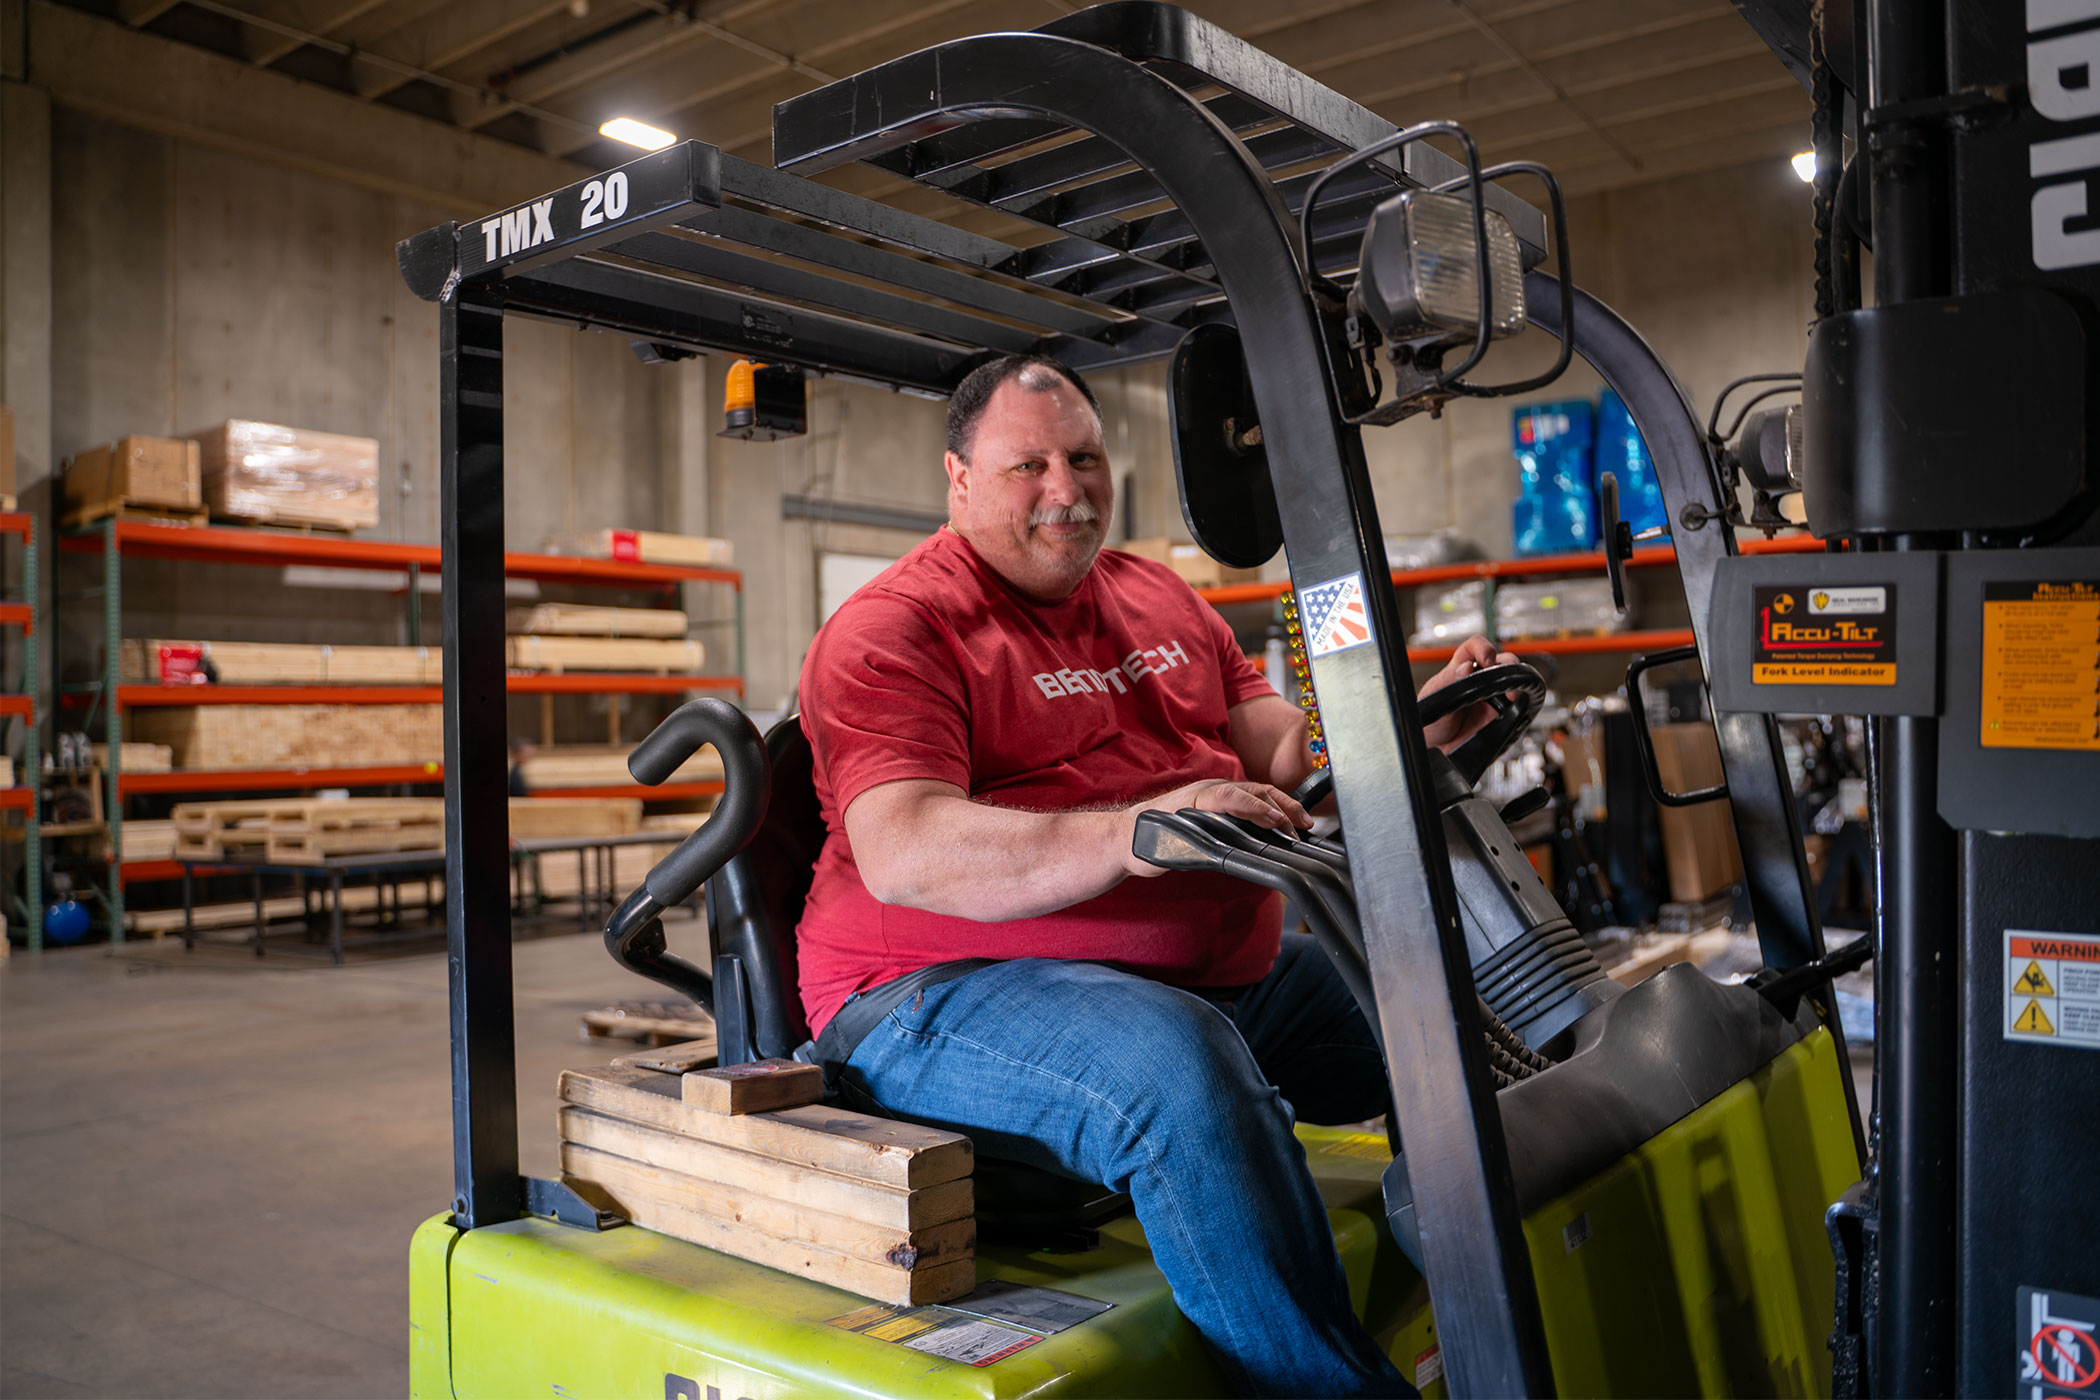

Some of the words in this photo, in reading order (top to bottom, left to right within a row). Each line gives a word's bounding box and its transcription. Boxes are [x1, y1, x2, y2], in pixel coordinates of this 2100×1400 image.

[481, 198, 555, 263] TMX
[580, 171, 628, 230] 20
[1316, 625, 1333, 646] MADE
[1328, 616, 1337, 624] IN
[1333, 600, 1346, 614] THE
[1342, 583, 1354, 599] USA
[1771, 621, 1878, 641] ACCU-TILT
[1762, 667, 1788, 676] Fork
[1792, 667, 1825, 676] Level
[1829, 667, 1885, 676] Indicator
[978, 1342, 1027, 1365] WARNING
